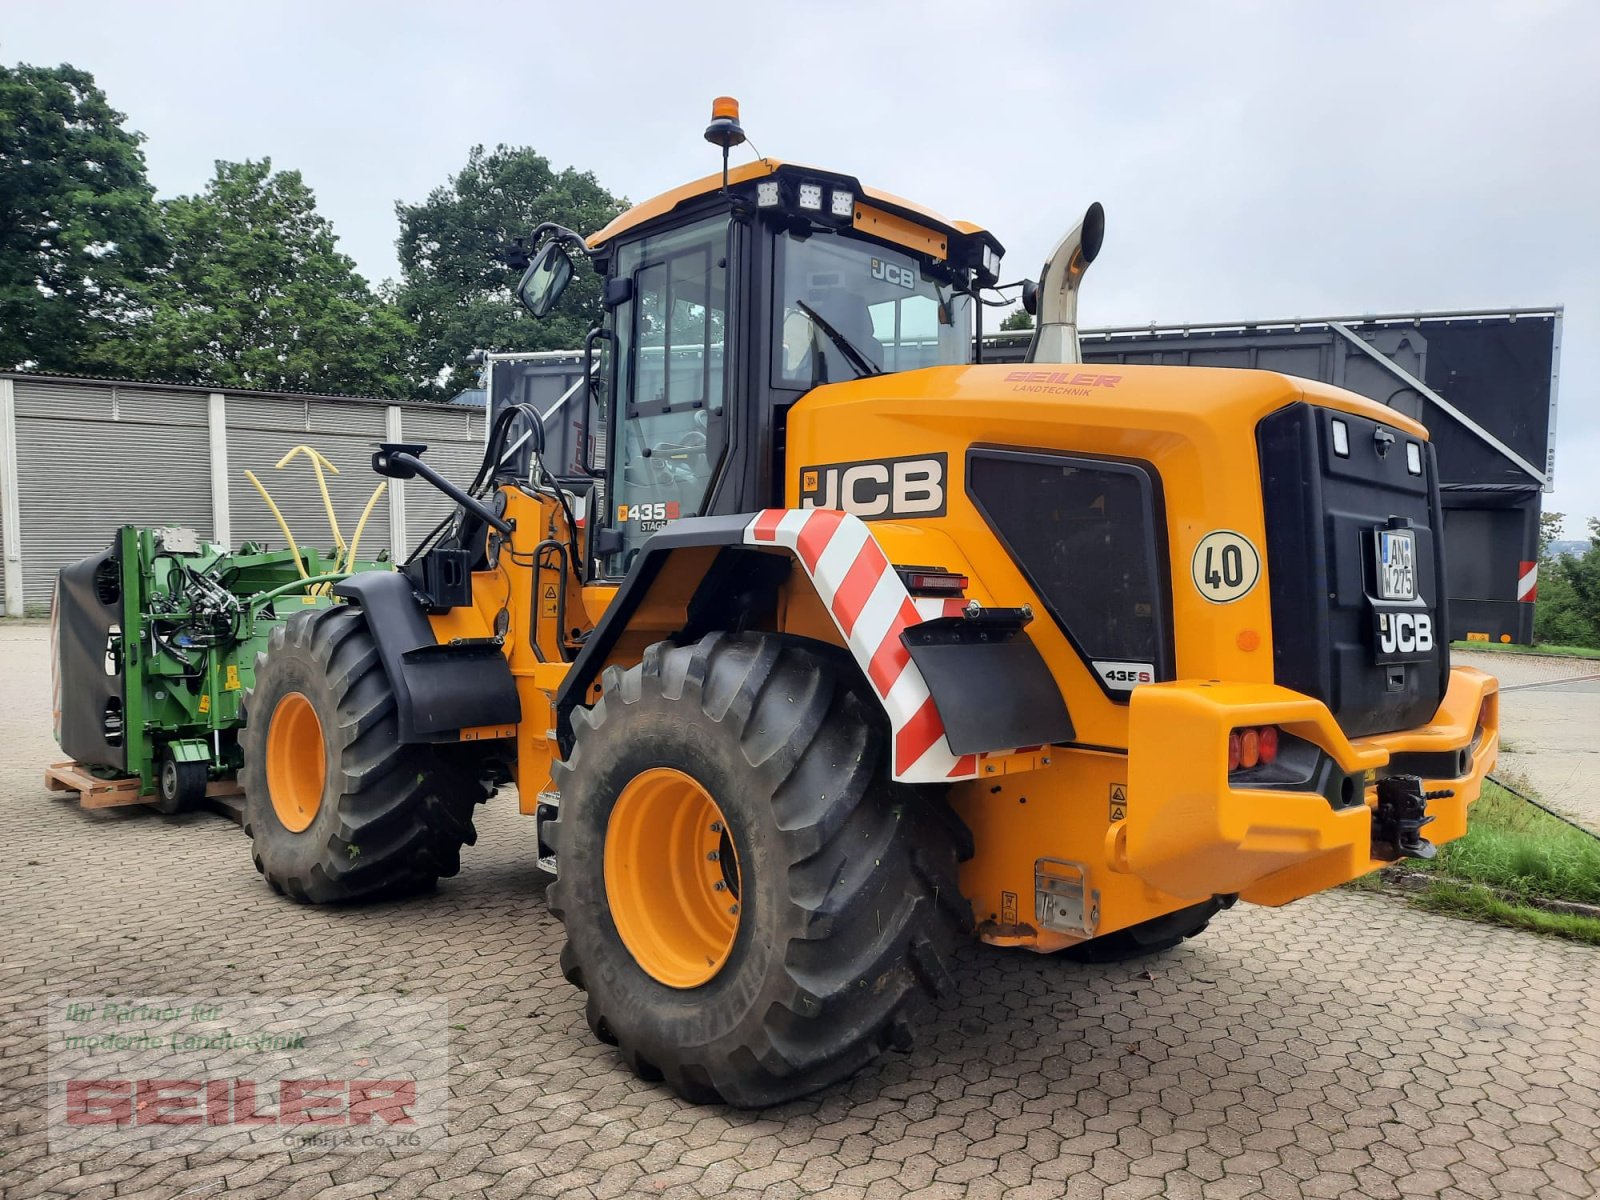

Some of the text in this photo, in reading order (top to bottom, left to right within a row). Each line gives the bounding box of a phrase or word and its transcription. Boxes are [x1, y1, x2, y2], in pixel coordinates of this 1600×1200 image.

[873, 261, 914, 289] JCB
[1004, 371, 1122, 388] GEILER
[1013, 385, 1093, 397] LANDTECHNIK
[803, 459, 943, 516] JCB
[1391, 540, 1404, 565] AN
[1205, 544, 1244, 589] 40
[1383, 567, 1412, 594] W 275
[1380, 613, 1433, 653] JCB
[1105, 670, 1151, 682] 435S
